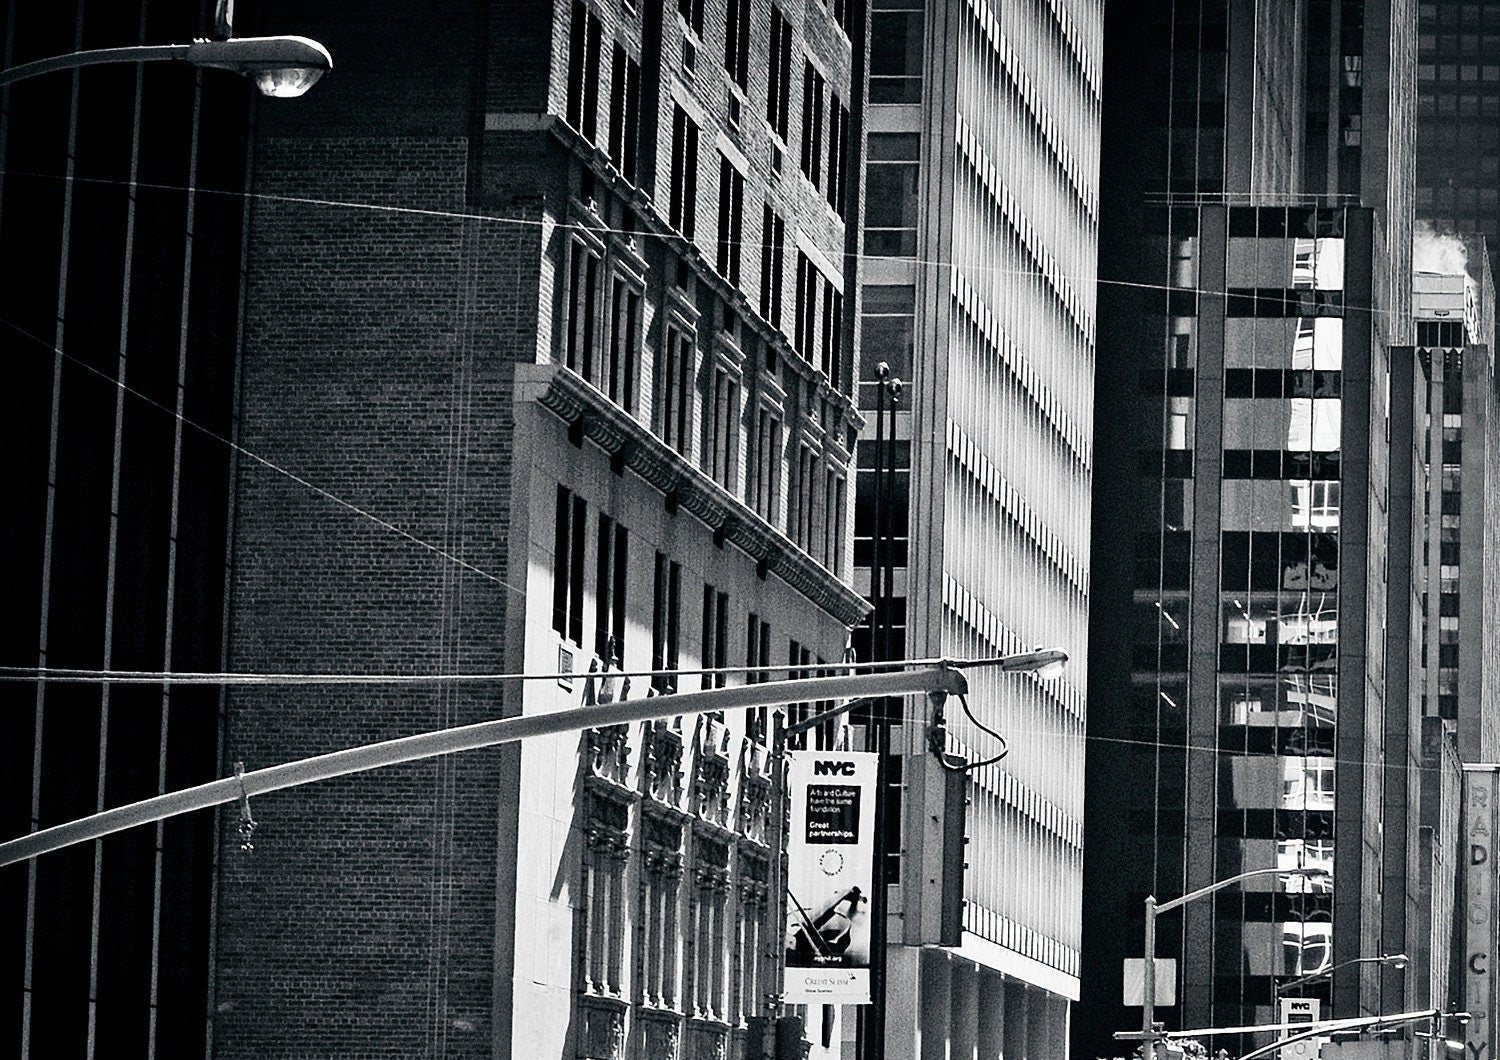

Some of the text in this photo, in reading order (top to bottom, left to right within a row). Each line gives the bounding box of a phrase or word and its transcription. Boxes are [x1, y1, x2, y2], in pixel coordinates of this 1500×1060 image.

[814, 760, 855, 776] NYC
[810, 821, 830, 829] Great
[1470, 785, 1489, 925] RADIO
[1291, 1002, 1310, 1010] NYC
